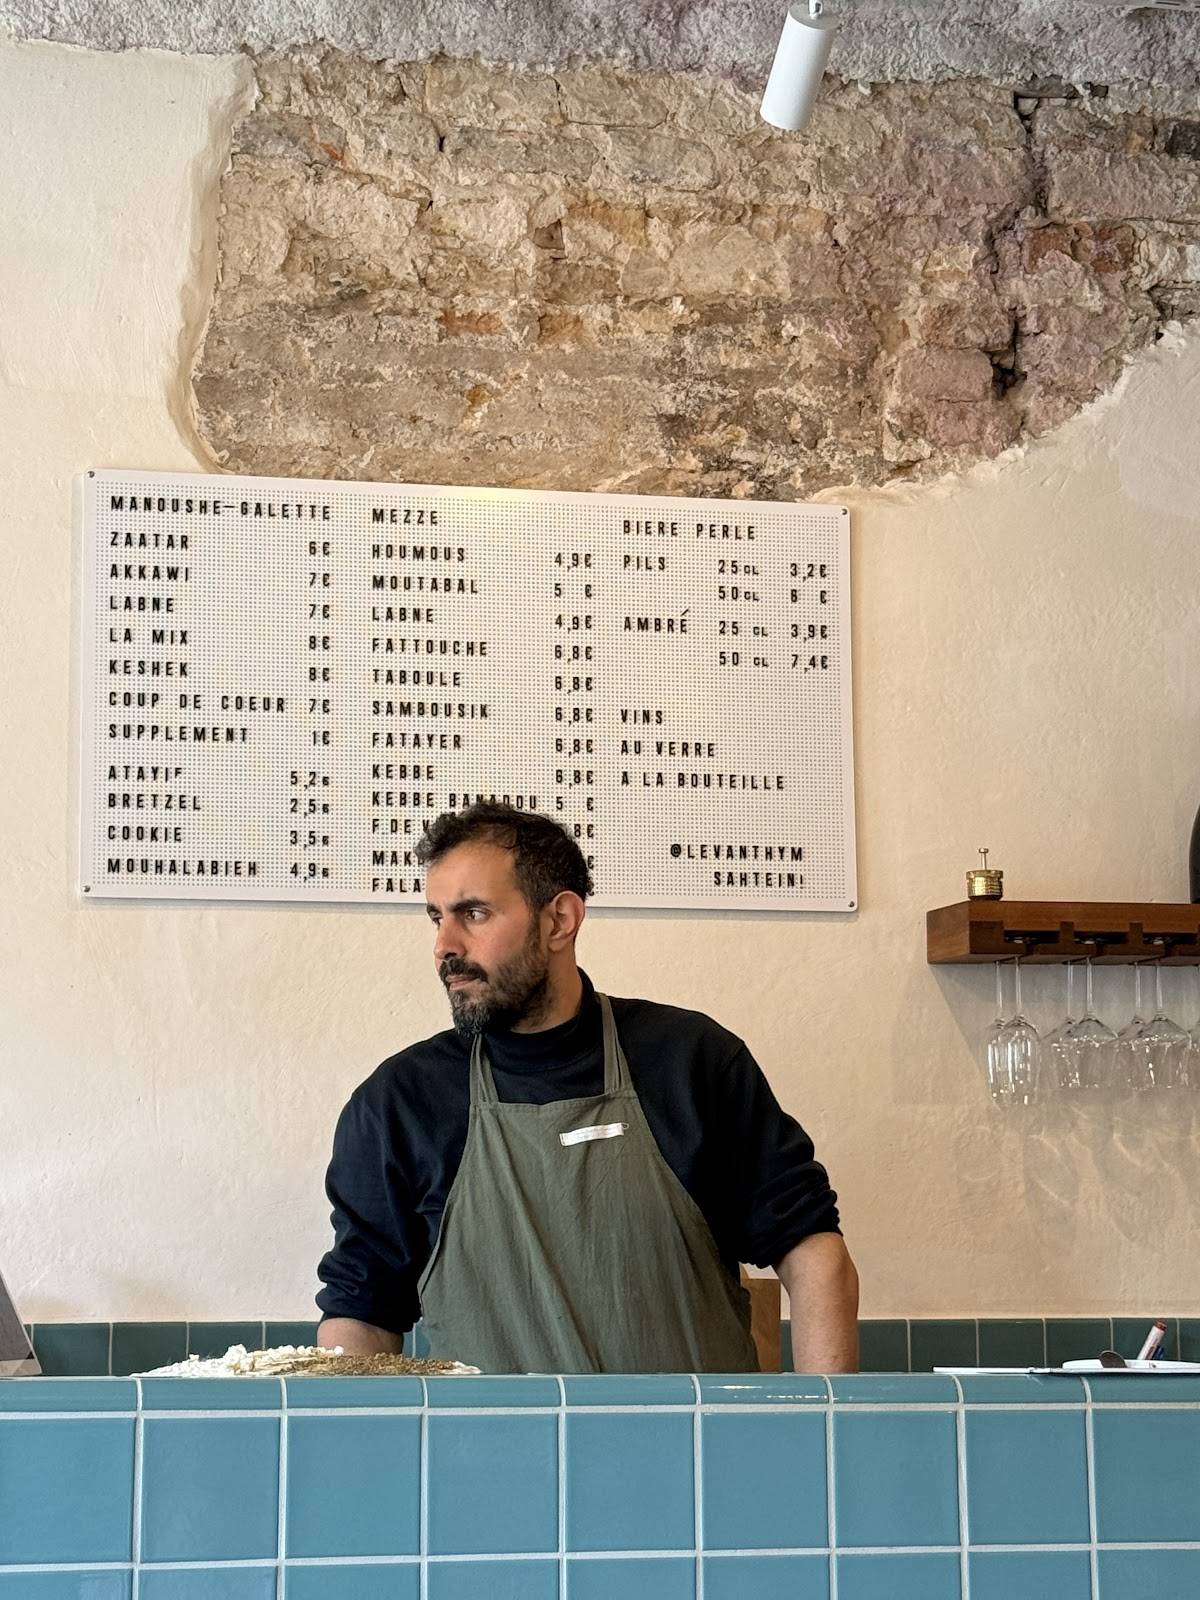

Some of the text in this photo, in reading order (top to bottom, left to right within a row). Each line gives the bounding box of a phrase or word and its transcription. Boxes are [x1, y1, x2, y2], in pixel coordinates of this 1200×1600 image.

[371, 508, 439, 525] MEZZE
[623, 520, 756, 540] BIERE PERLE
[110, 531, 331, 556] ZAATAR 6€
[371, 544, 592, 572] HOUMOUS 4,9€
[623, 555, 666, 571] PILS
[789, 563, 827, 582] 3,2€
[110, 563, 331, 588] AKKAWI 7€
[371, 575, 479, 594] MOUTABAL
[553, 584, 562, 598] 5
[110, 596, 331, 620] LABNE 7€
[371, 607, 593, 634] LABNE 4,9€
[623, 608, 828, 643] AMBRÉ 25 CL 3,9€
[109, 628, 331, 650] LA MIX 8€
[371, 638, 593, 662] FATTOUCHE 6,8€
[109, 660, 331, 682] KESHEK 8€
[718, 651, 828, 673] 50 CL 7,4€
[371, 669, 593, 693] TABOULE 6,8€
[109, 691, 331, 714] COUP DE COEUR 7€
[371, 700, 593, 726] SAMBOUSIK 6,8€
[620, 709, 665, 725] VINS
[108, 724, 331, 746] SUPPLEMENT 1€
[371, 732, 594, 758] FATAYER 6,8€
[620, 740, 717, 758] AU VERRE
[107, 765, 183, 783] ATAYIF
[371, 764, 594, 789] KEBBE 6,8€
[620, 771, 785, 790] A LA BOUTEILLE
[107, 793, 202, 811] BRETZEL
[371, 791, 435, 808] KEBBE
[555, 797, 564, 810] 5
[107, 825, 183, 843] COOKIE
[573, 823, 595, 838] 8€
[371, 851, 424, 866] MAK
[670, 843, 803, 862] @LEVANTHYM
[107, 858, 258, 877] MOUHALABIEH
[713, 871, 804, 889] SAHTEIN!
